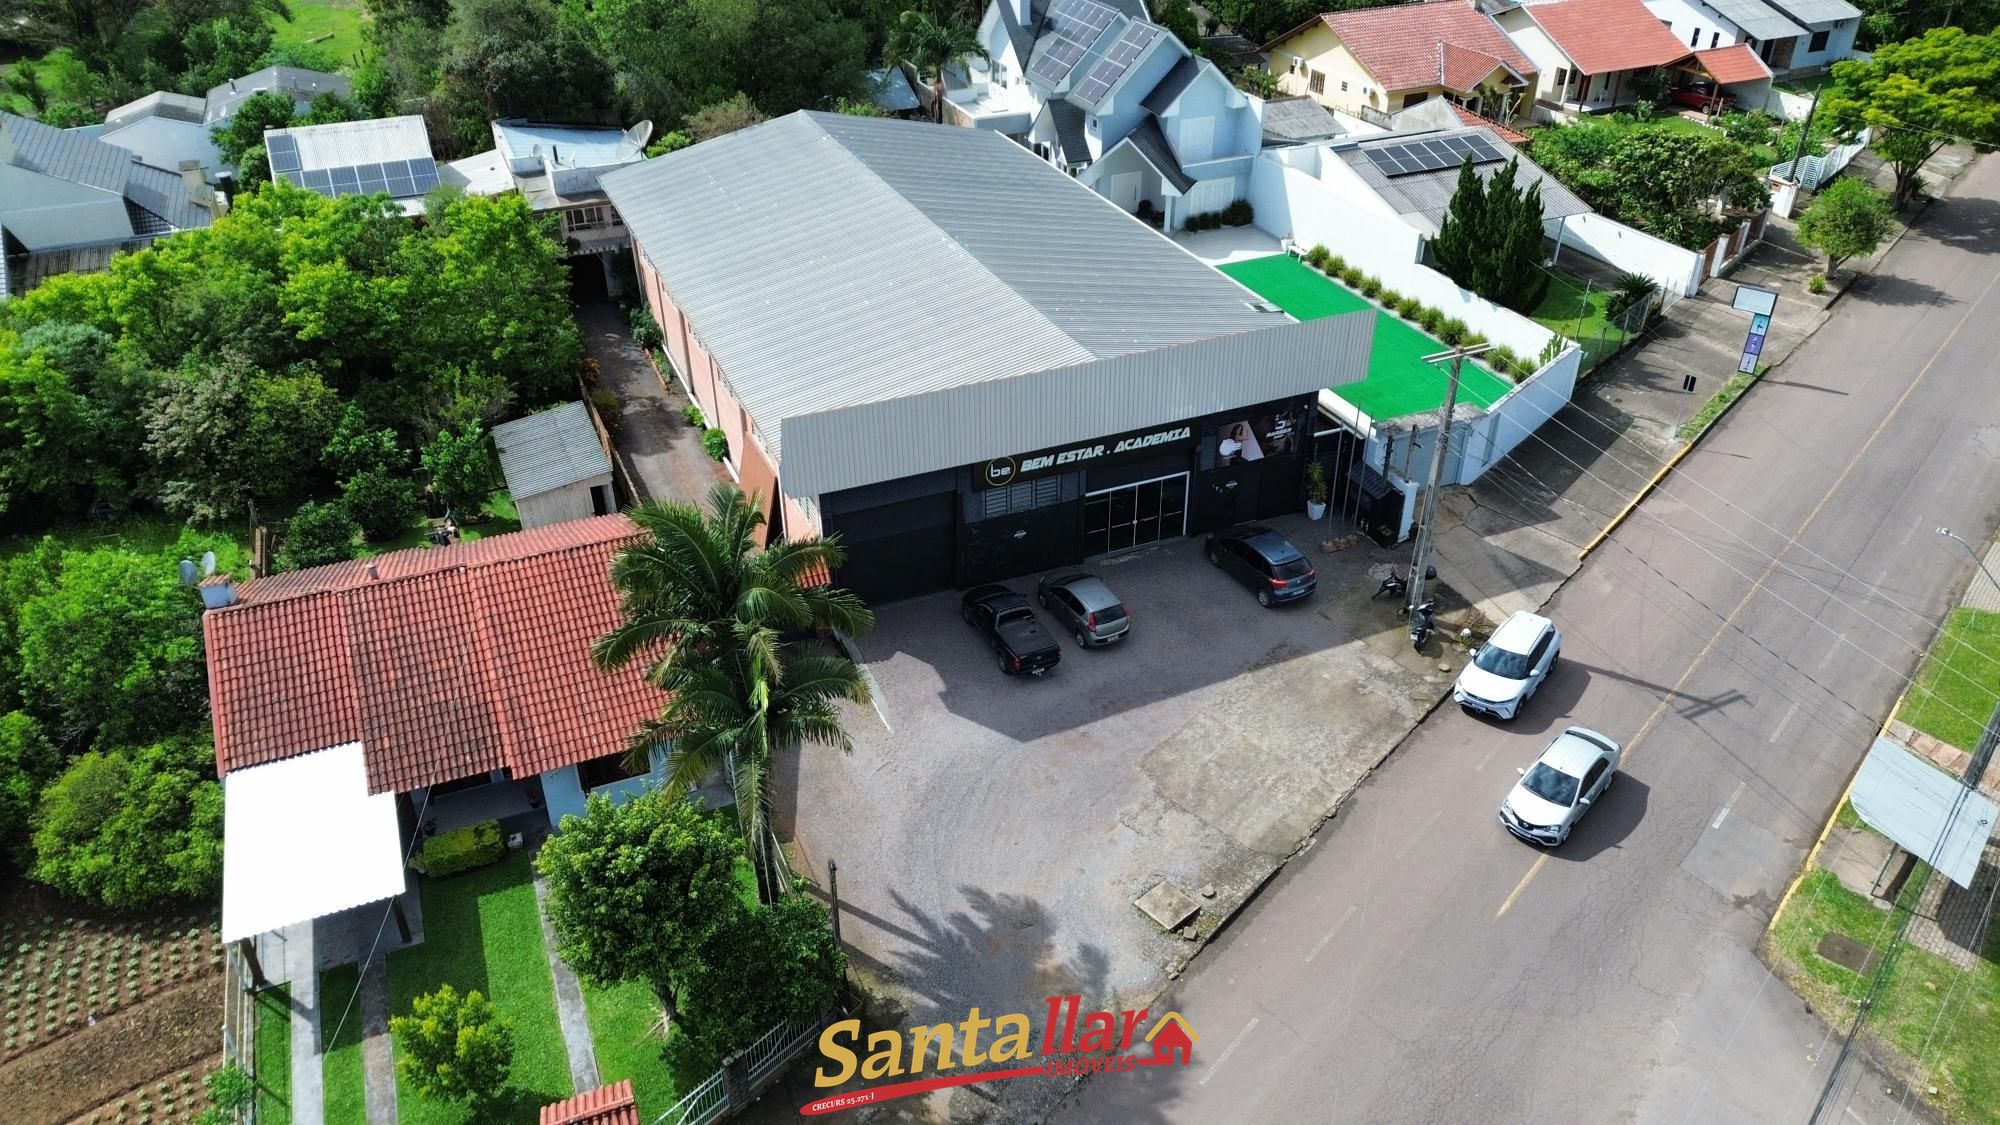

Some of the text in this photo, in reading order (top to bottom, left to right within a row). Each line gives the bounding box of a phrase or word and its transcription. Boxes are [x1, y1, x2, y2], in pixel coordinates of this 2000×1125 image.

[1020, 455, 1055, 472] BEM
[1056, 445, 1105, 465] ESTAR
[1114, 426, 1191, 453] ACADEMIA
